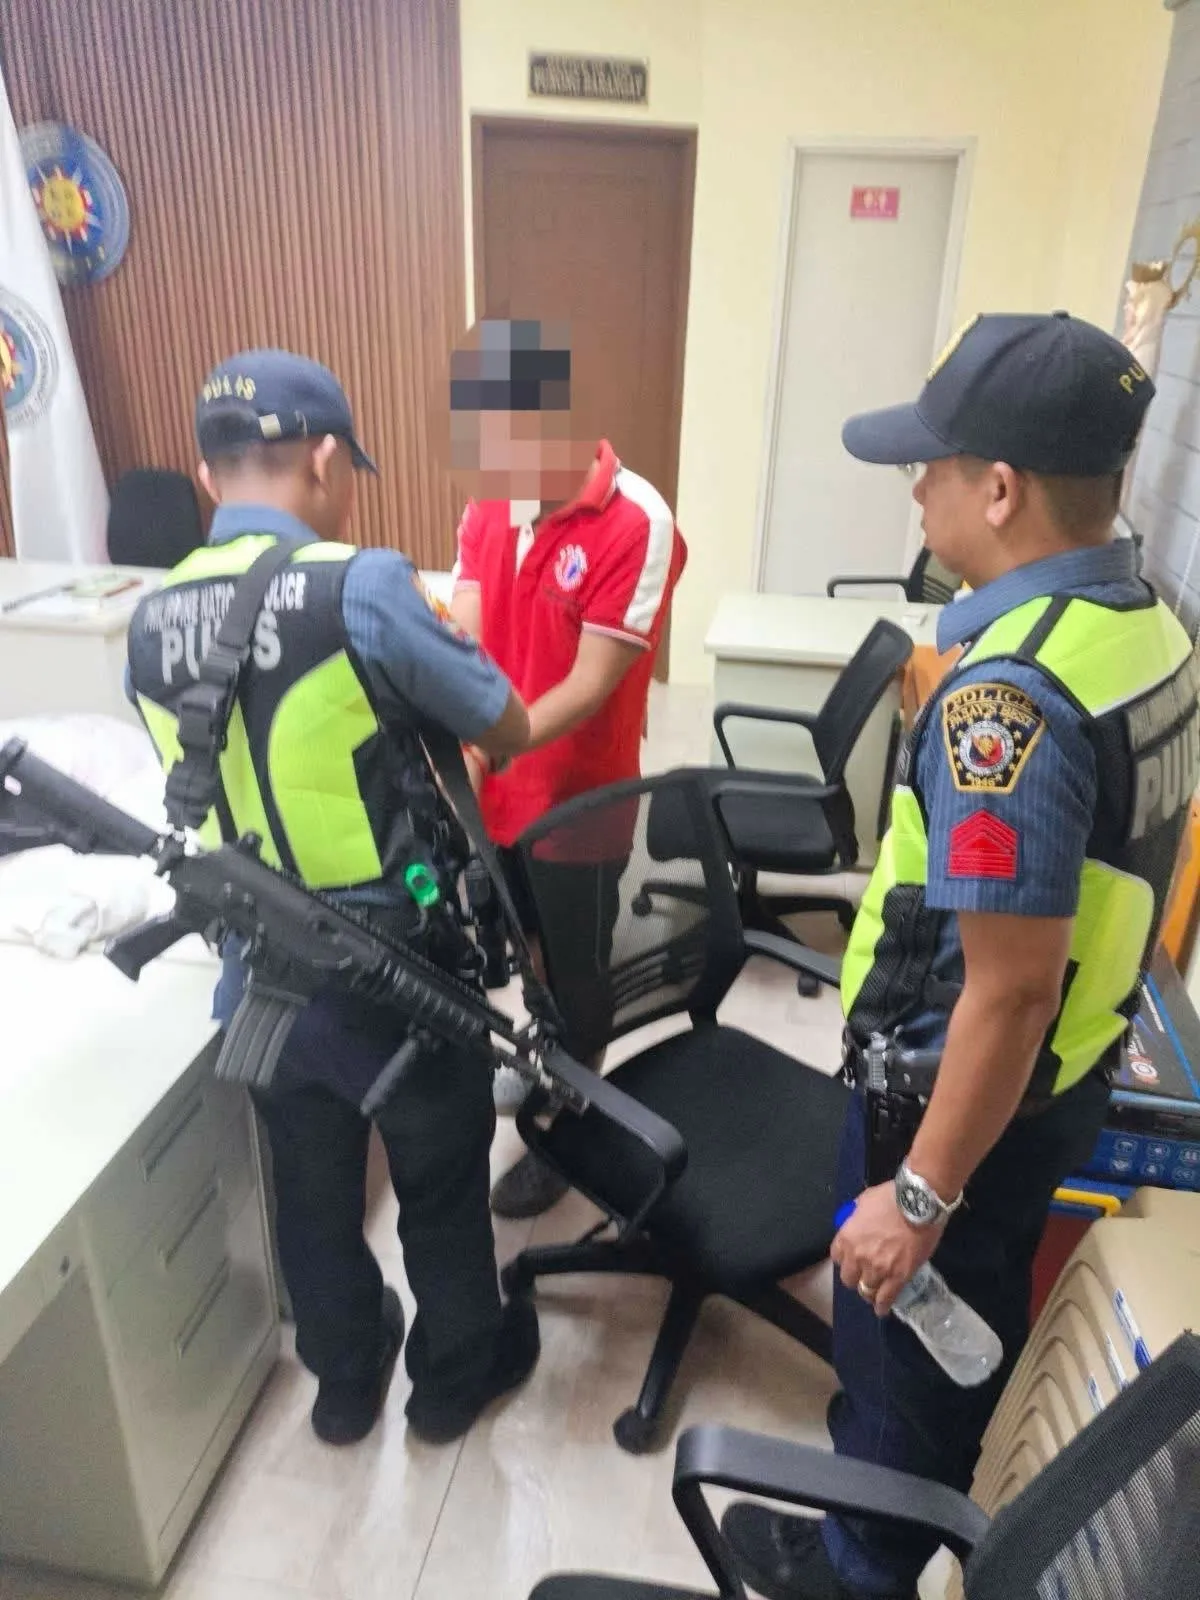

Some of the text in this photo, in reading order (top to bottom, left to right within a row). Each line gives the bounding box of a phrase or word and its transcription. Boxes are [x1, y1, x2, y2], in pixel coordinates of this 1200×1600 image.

[263, 572, 306, 612] OLICE
[161, 609, 281, 686] PUS
[951, 687, 1035, 715] POLICE
